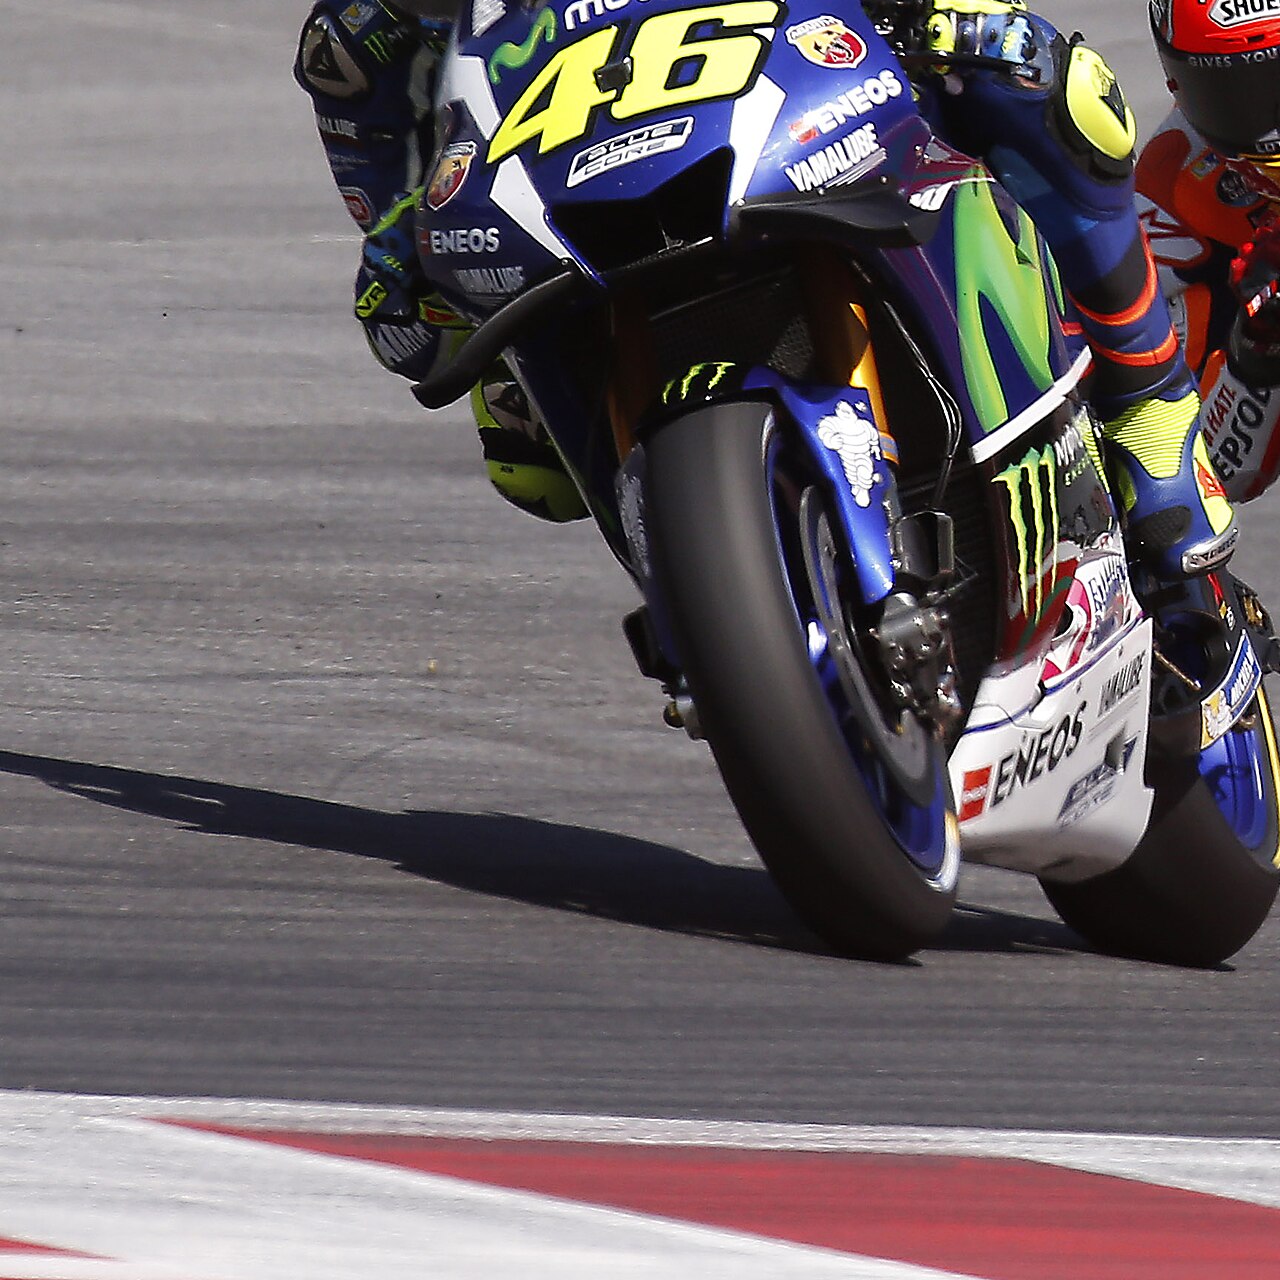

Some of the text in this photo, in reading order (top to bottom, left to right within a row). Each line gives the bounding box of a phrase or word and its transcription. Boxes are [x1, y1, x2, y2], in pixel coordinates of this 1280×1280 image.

[486, 0, 784, 164] 46
[1188, 56, 1232, 68] GIVES
[1241, 47, 1278, 64] YOU
[814, 69, 902, 134] ENEOS
[785, 121, 880, 191] YAMALUBE
[430, 228, 500, 254] ENEOS
[1212, 387, 1271, 481] EPSOL
[991, 701, 1087, 807] ENEOS
